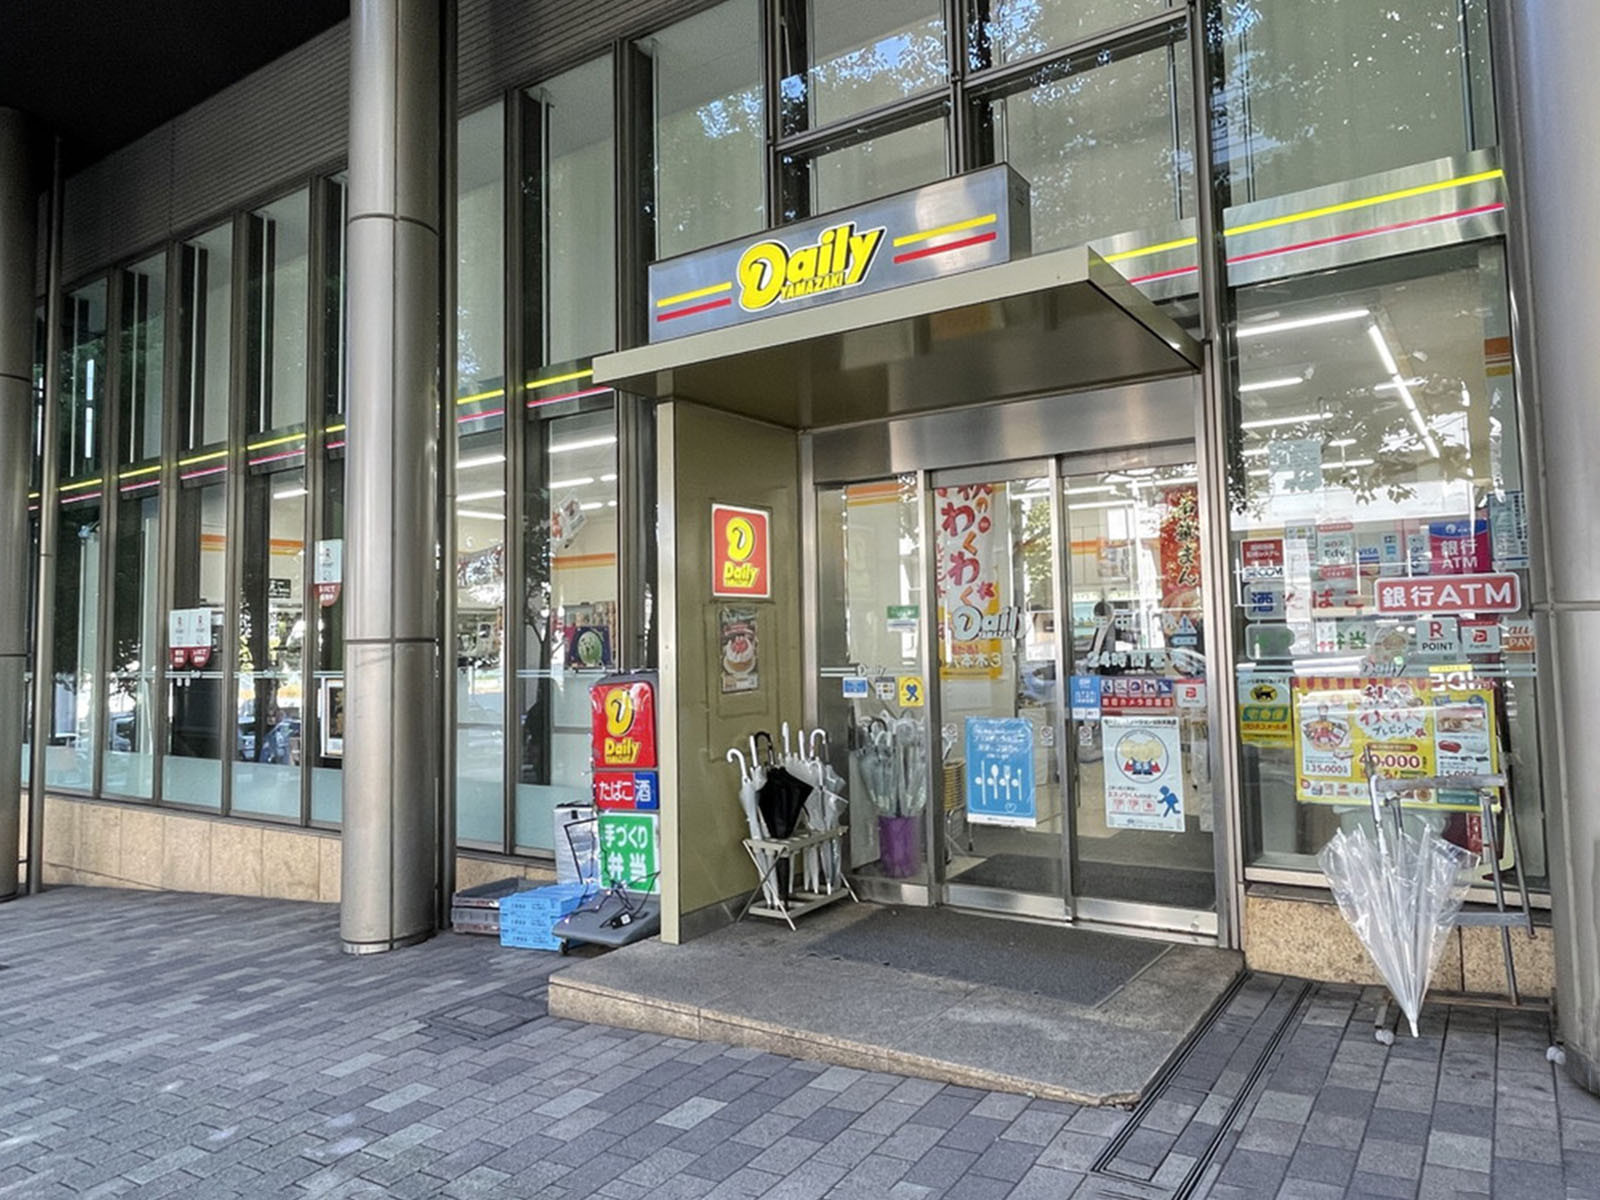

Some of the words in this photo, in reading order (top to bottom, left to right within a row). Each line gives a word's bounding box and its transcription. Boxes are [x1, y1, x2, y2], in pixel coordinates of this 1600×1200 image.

[738, 222, 886, 311] Daily
[780, 271, 847, 300] YAMAZAKI
[1441, 539, 1477, 556] 銀行
[723, 562, 759, 587] Daily
[1442, 556, 1478, 569] ATM
[1251, 591, 1274, 612] 酒
[1382, 582, 1513, 608] 銀行ATM
[1422, 642, 1454, 651] POINT
[1508, 636, 1533, 648] PAY
[604, 737, 643, 764] Daily
[599, 780, 634, 801] たばこ
[634, 779, 651, 802] 酒
[604, 823, 648, 849] 手づくり
[607, 852, 648, 884] 弁当
